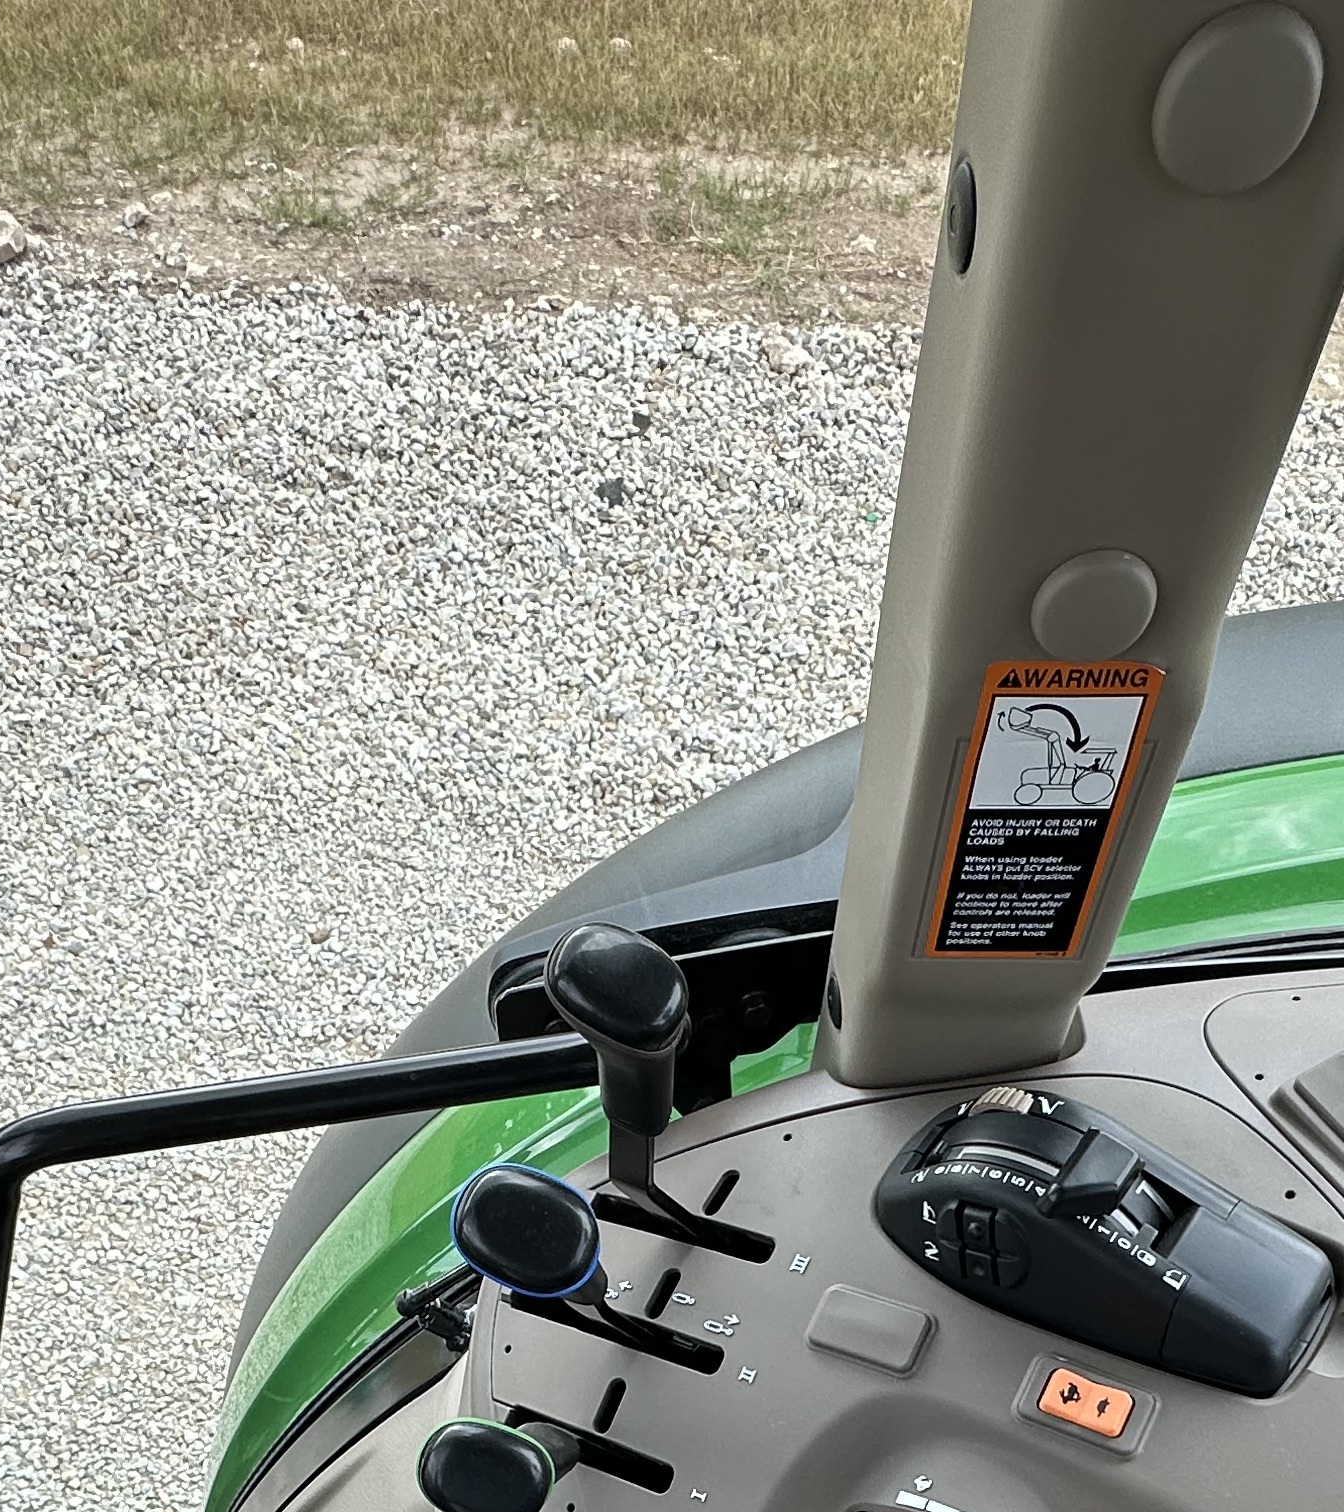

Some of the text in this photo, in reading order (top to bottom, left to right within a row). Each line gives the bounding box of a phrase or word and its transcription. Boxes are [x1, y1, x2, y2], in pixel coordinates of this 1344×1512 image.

[1024, 668, 1150, 689] WARNING
[970, 819, 1098, 827] AVOID INJURY OR DEATH
[968, 828, 1080, 837] CAUSED BY FALLING
[966, 837, 1005, 846] LOADS
[964, 855, 1064, 865] When using loader
[962, 864, 1082, 873] ALWAYS put SCV selector
[965, 893, 984, 901] you
[954, 900, 998, 908] continue
[1039, 900, 1063, 908] after
[1018, 921, 1054, 929] manual
[989, 1169, 1002, 1179] 6
[1010, 1175, 1026, 1187] 5
[1035, 1185, 1046, 1197] 4
[1097, 1225, 1111, 1235] 1
[1117, 1237, 1131, 1250] 0
